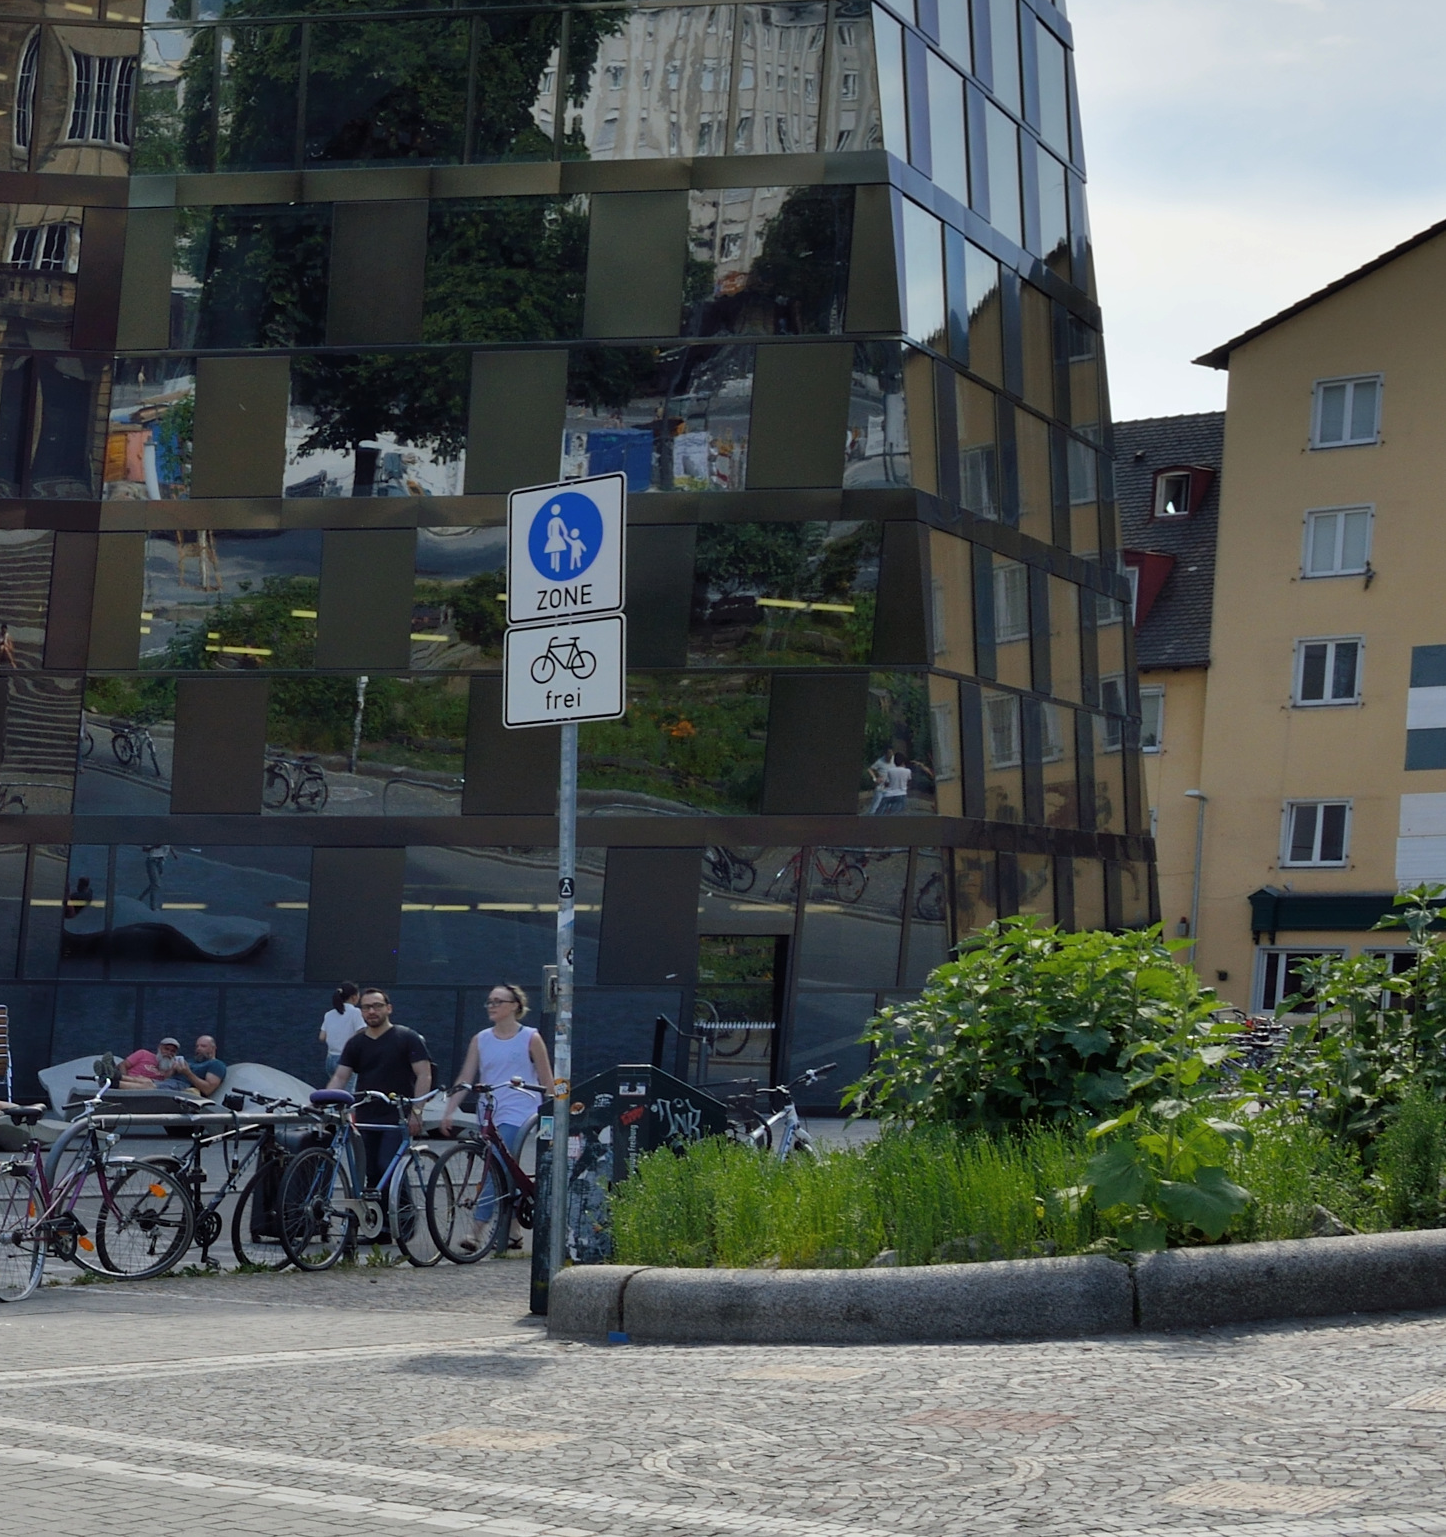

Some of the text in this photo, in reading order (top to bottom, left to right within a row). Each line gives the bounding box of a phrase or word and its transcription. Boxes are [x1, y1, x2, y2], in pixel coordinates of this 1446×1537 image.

[536, 584, 593, 611] ZONE
[545, 687, 581, 710] frei
[627, 1124, 639, 1151] Freiburg
